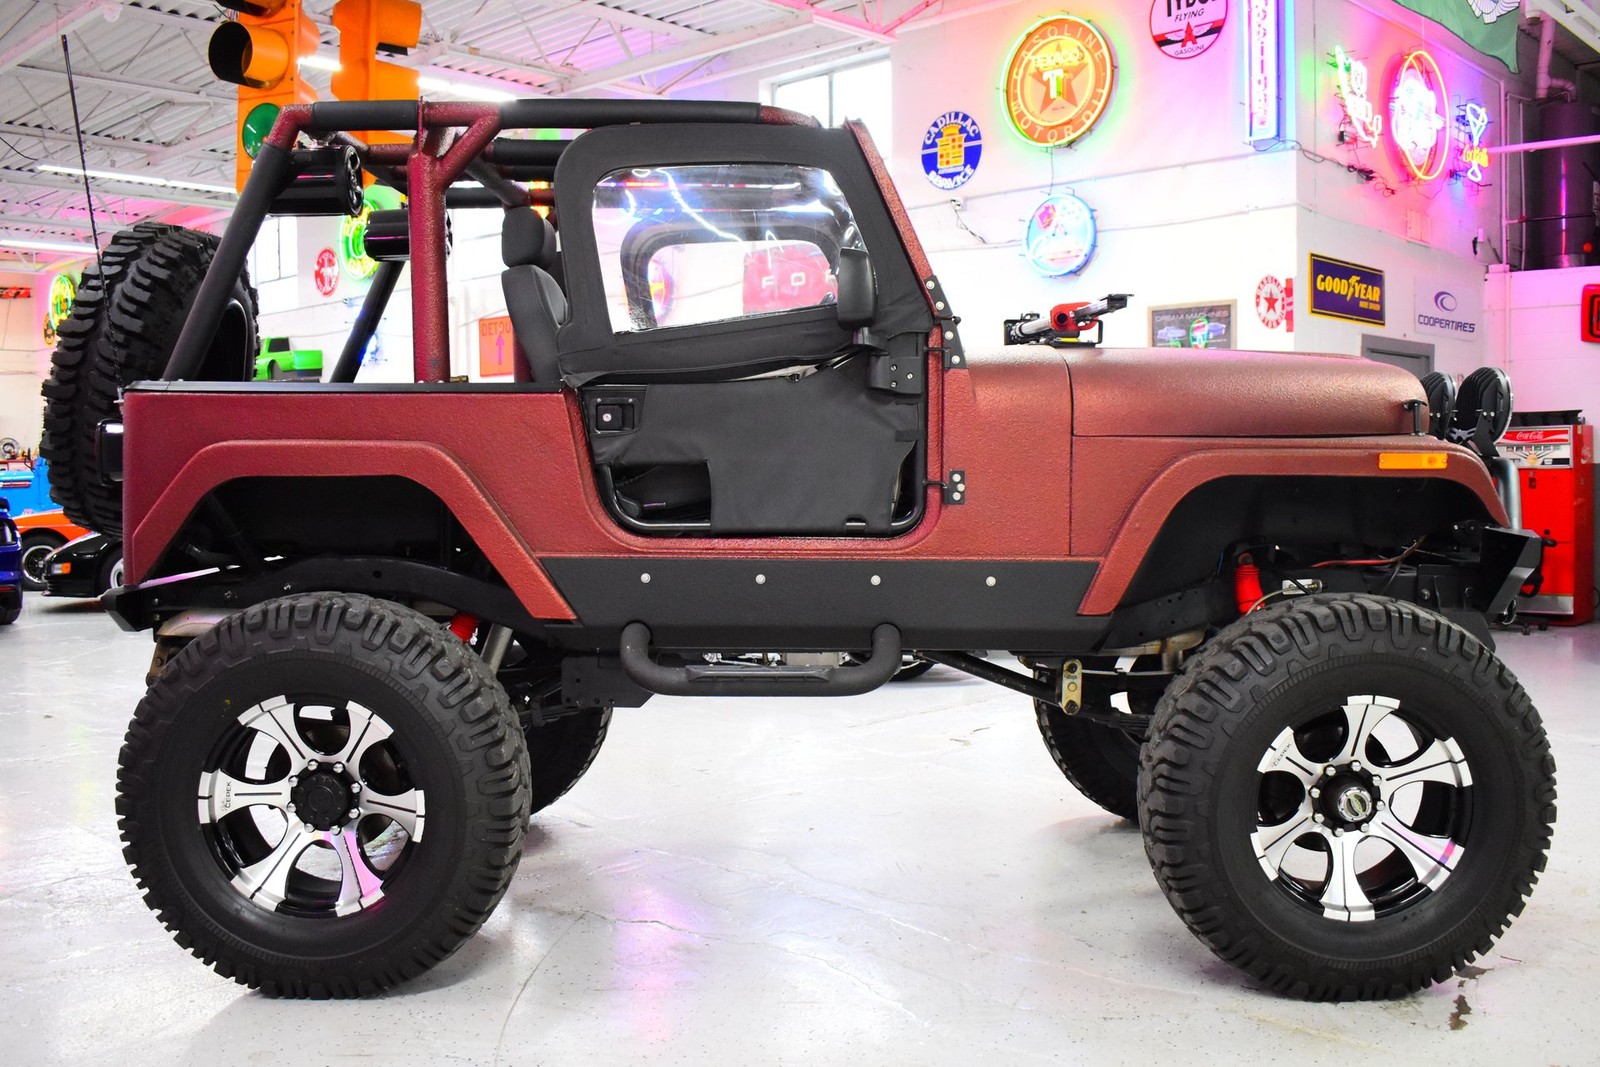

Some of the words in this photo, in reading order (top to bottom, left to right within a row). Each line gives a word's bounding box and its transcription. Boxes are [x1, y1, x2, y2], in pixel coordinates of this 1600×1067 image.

[1174, 8, 1205, 22] FLYING
[1012, 24, 1105, 80] GASOLINE
[1027, 48, 1082, 67] TEXACO
[1174, 44, 1205, 56] GASOLINE
[1012, 100, 1075, 143] MOTOR
[1081, 88, 1105, 124] OIL
[924, 111, 980, 145] CADILLAC
[1316, 274, 1381, 302] GOODYEAR
[481, 321, 512, 337] DETOU
[1418, 314, 1476, 333] COOPERTIRES
